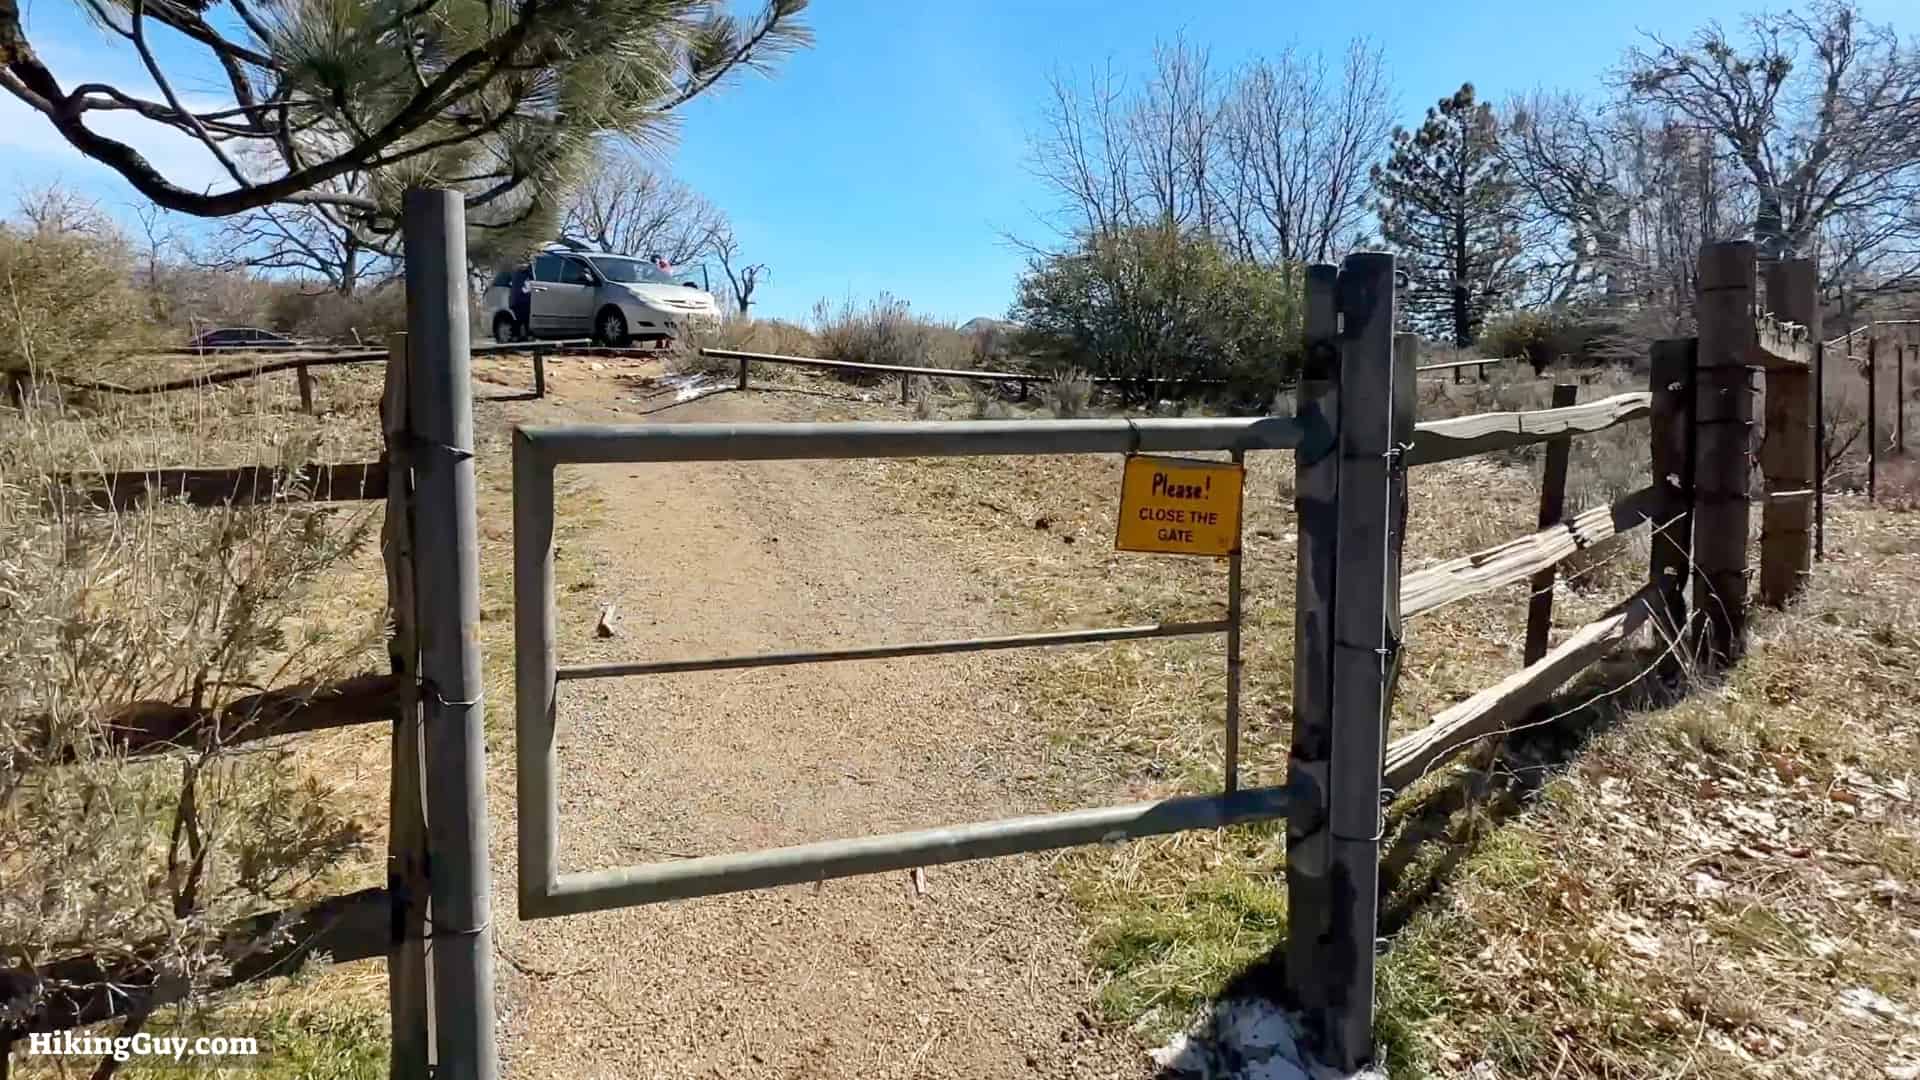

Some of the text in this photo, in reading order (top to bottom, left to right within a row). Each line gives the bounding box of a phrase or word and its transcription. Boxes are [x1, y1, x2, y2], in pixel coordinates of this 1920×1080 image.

[1152, 472, 1211, 500] Please!
[1139, 507, 1217, 525] CLOSE THE
[1157, 528, 1193, 543] GATE
